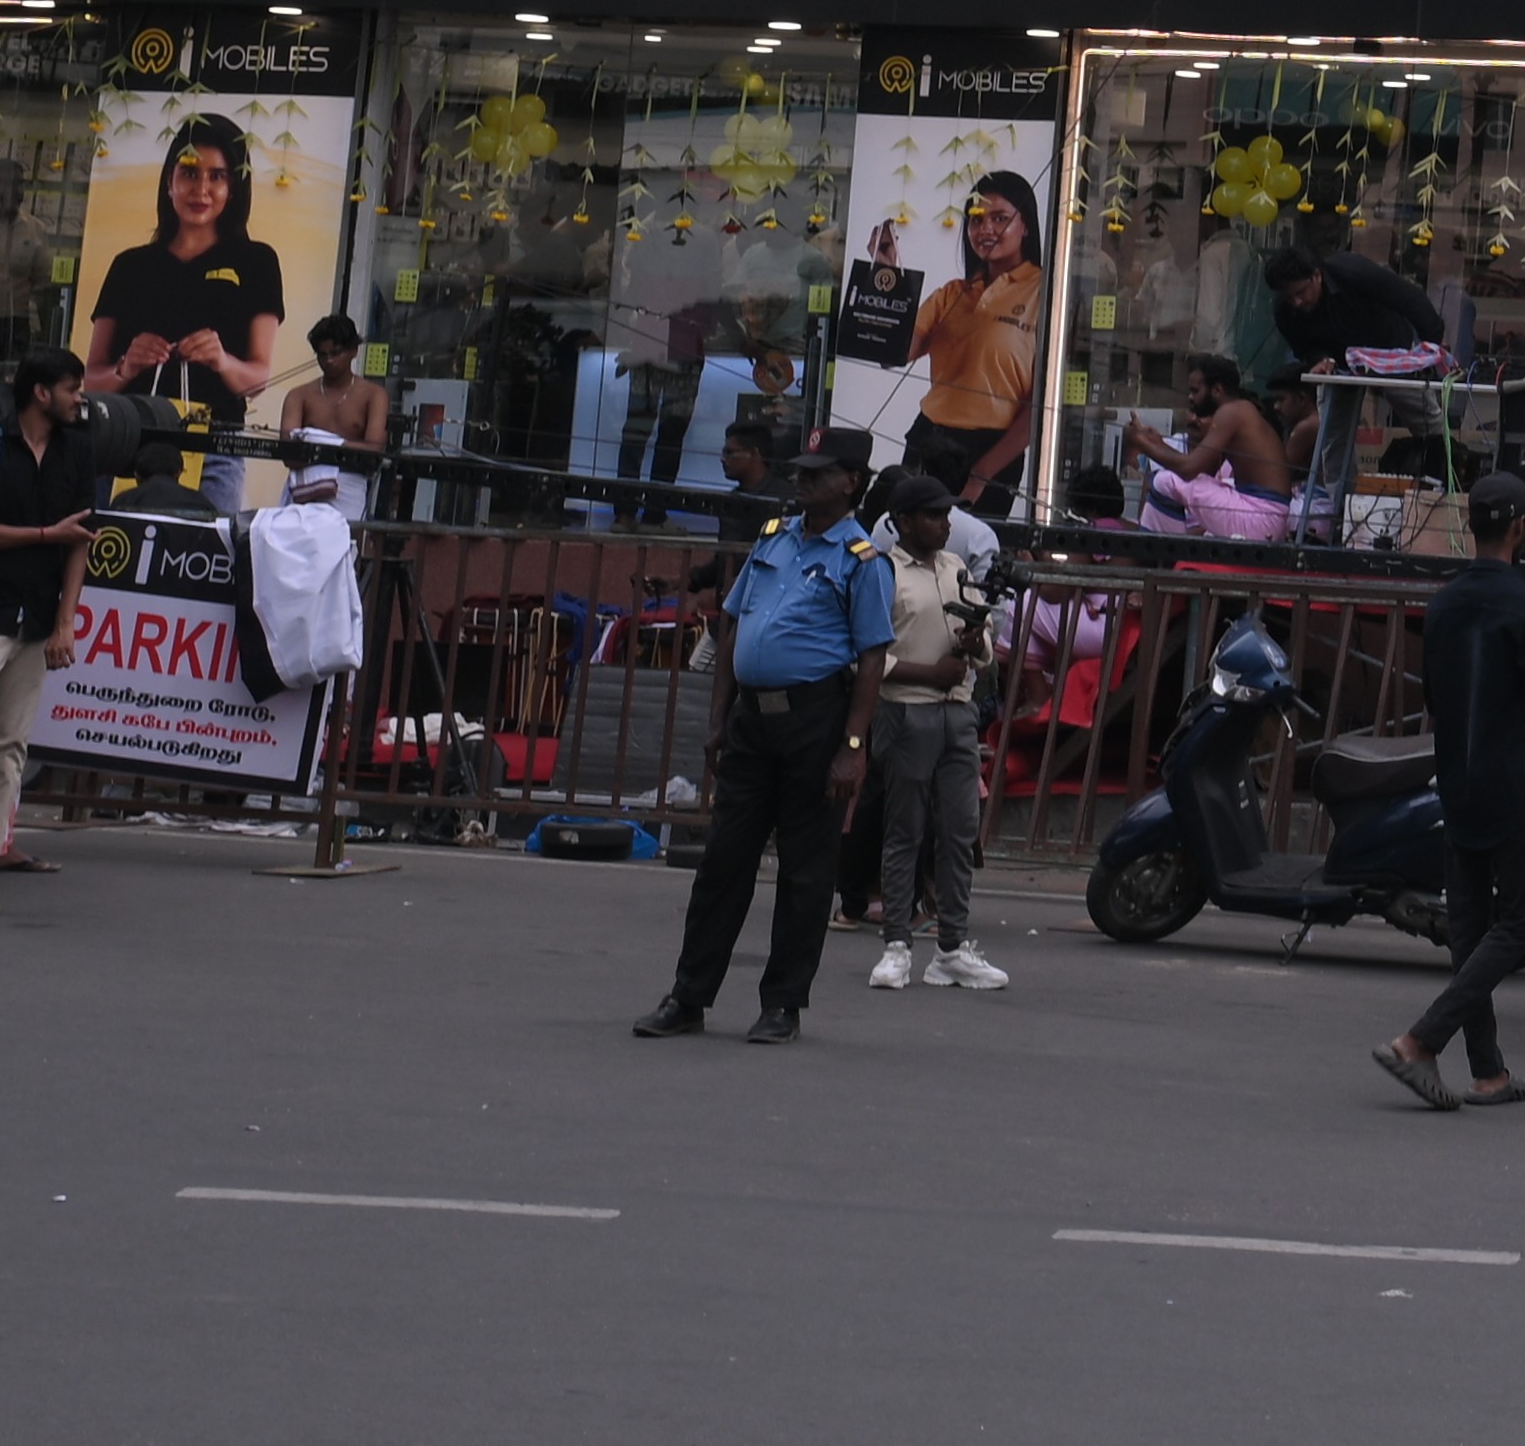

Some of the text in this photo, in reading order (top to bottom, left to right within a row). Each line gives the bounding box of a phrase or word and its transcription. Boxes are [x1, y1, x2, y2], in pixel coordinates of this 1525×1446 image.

[201, 44, 330, 73] MOBILES
[938, 68, 1047, 94] MOBILES
[74, 605, 241, 684] PARKI
